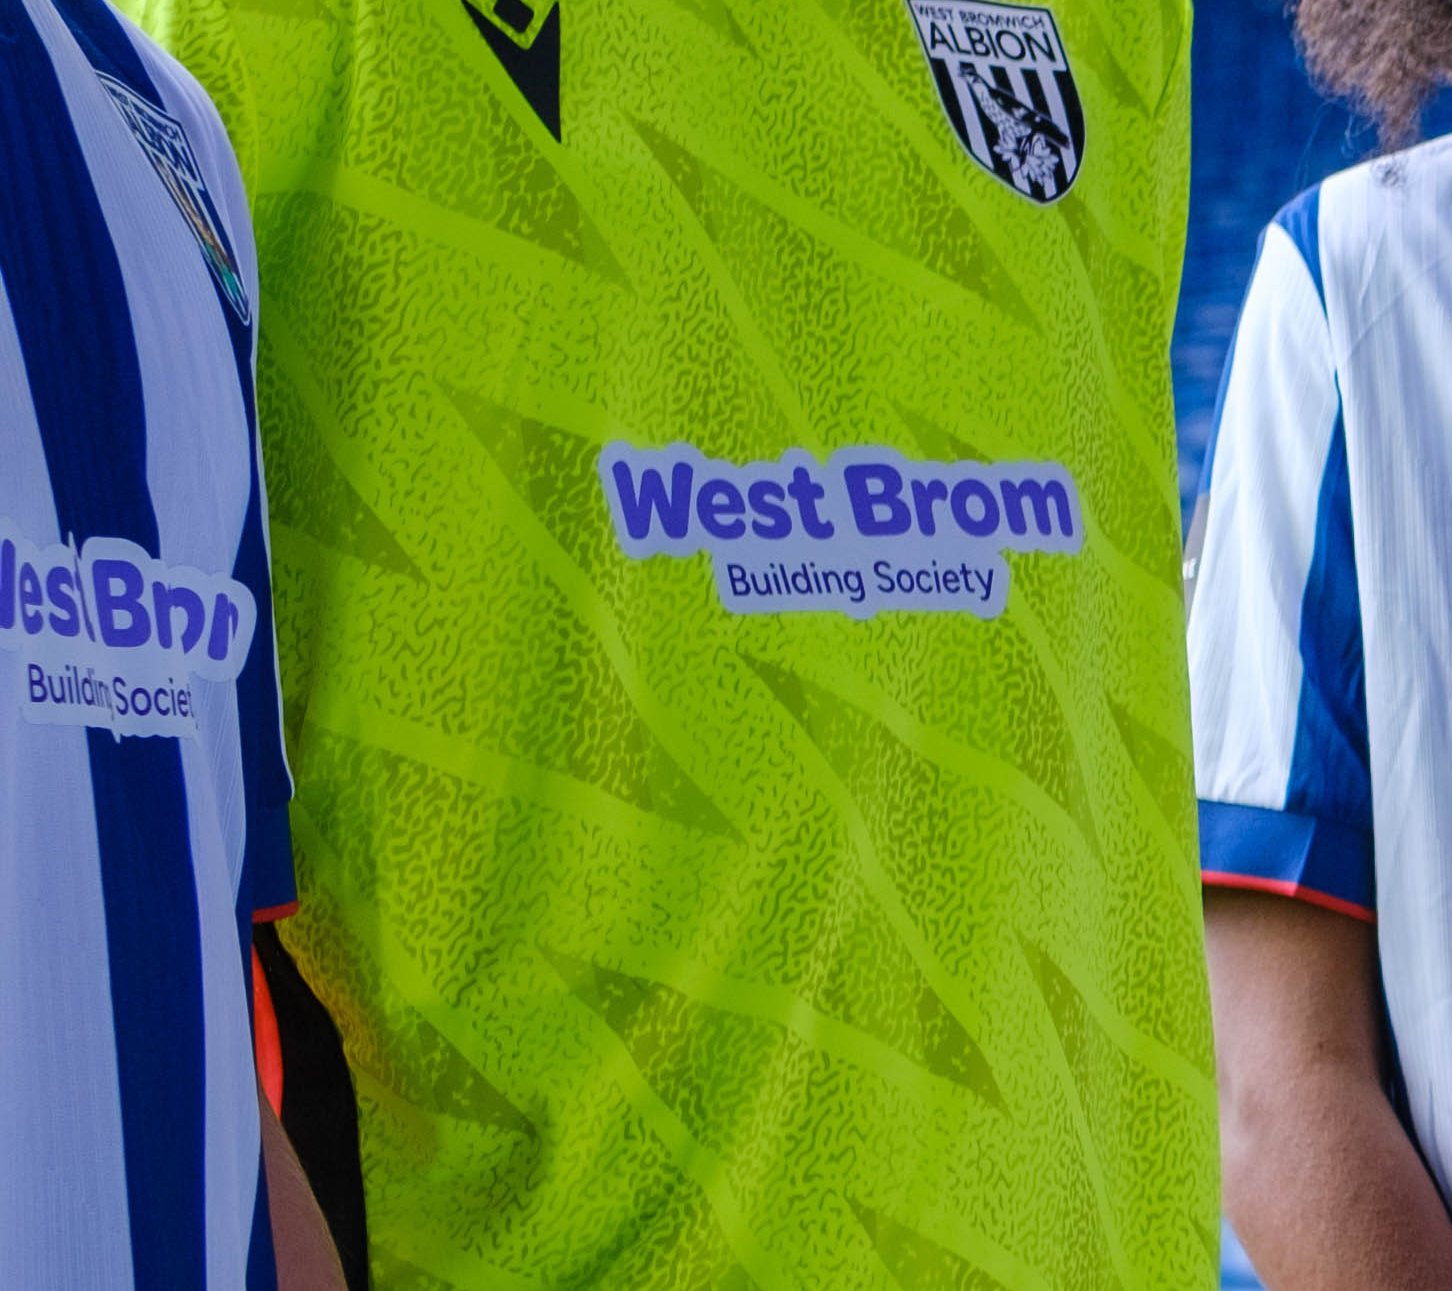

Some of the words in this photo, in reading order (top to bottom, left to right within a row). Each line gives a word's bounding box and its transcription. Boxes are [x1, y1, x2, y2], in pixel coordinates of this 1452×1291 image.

[915, 4, 954, 22] WEST
[959, 10, 1045, 30] BROMWICH
[930, 22, 1057, 62] ALBION
[612, 460, 835, 540] West
[844, 463, 1073, 537] Brom
[727, 562, 864, 603] Building
[873, 559, 994, 601] Society
